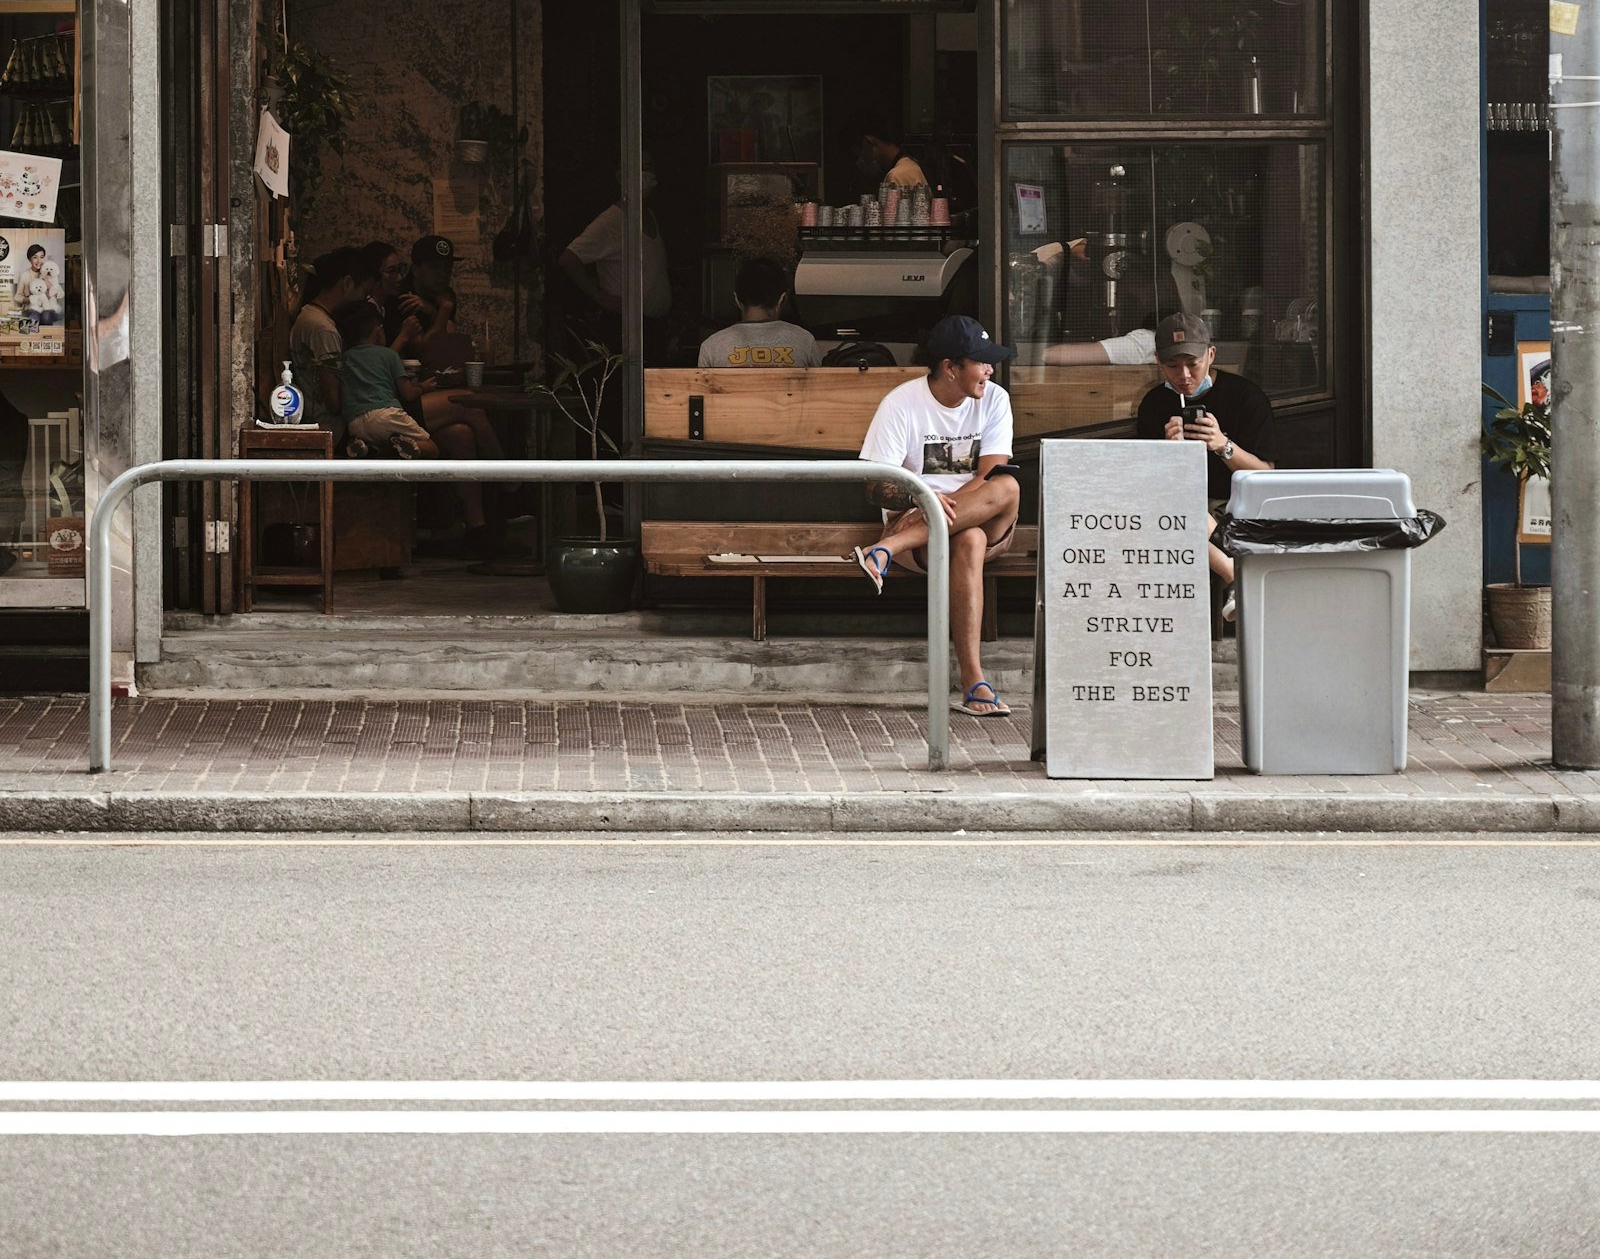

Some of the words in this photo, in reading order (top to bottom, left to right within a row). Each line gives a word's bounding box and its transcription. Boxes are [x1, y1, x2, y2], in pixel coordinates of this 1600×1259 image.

[728, 345, 795, 364] JOX
[1070, 514, 1142, 531] FOCUS
[1158, 515, 1187, 531] ON
[1062, 548, 1106, 565] ONE
[1122, 549, 1195, 565] THING
[1062, 583, 1092, 599] AT
[1107, 583, 1123, 599] A
[1138, 583, 1195, 599] TIME
[1086, 617, 1174, 633] STRIVE
[1108, 651, 1153, 667] FOR
[1072, 686, 1115, 702] THE
[1132, 686, 1190, 702] BEST
